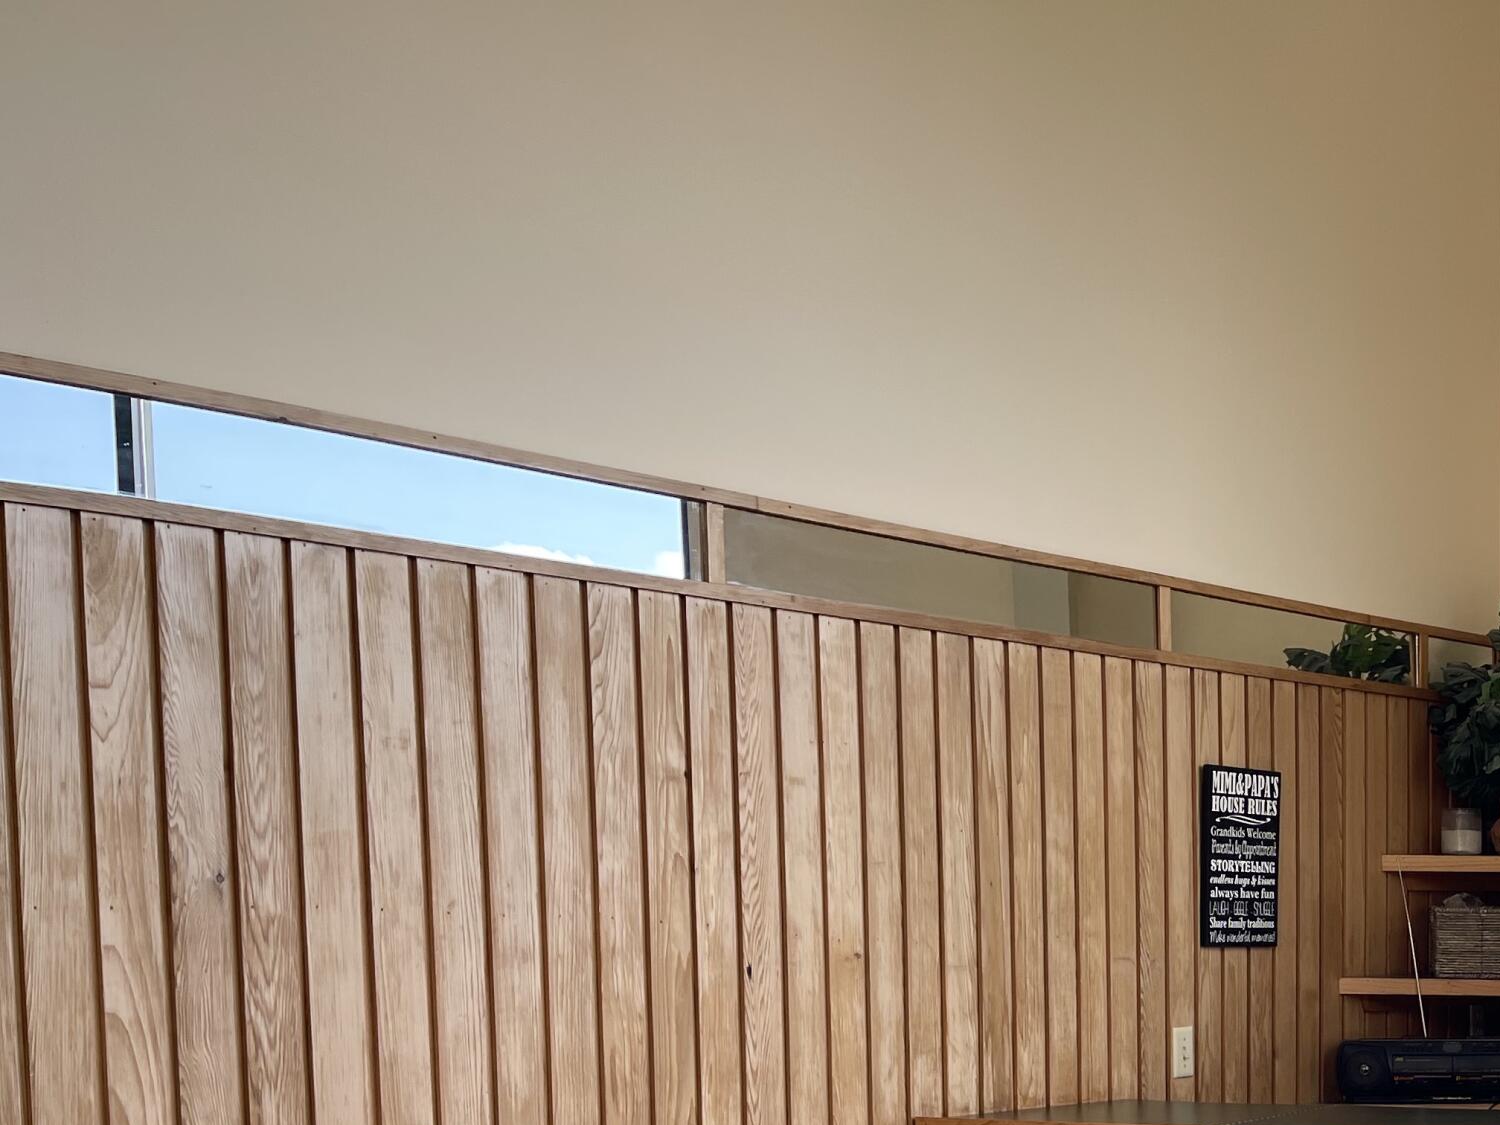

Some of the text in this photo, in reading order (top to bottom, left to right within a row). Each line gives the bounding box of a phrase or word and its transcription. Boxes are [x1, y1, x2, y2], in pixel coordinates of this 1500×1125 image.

[1211, 795, 1277, 816] HOUSE RULES
[1210, 825, 1276, 840] Grandkids Welcome
[1210, 859, 1275, 874] STORYTELLING
[1210, 874, 1234, 884] endless
[1234, 874, 1250, 887] hugs
[1210, 886, 1275, 901] always have fun
[1209, 916, 1275, 931] Share family traditions
